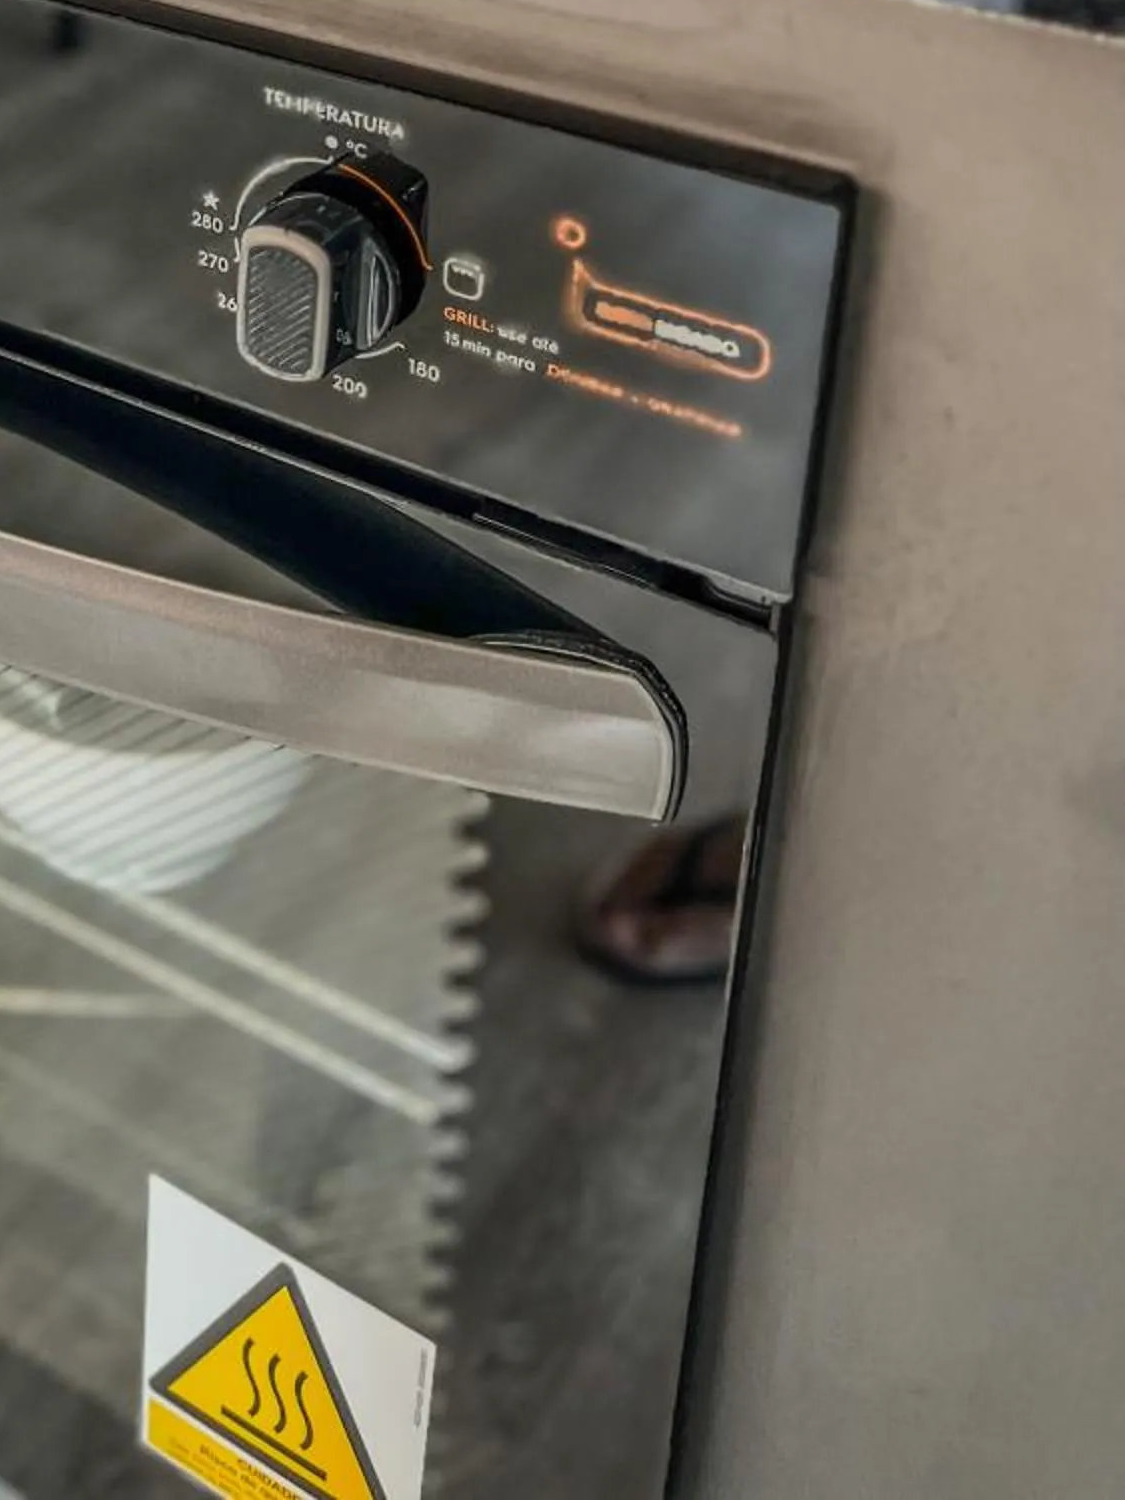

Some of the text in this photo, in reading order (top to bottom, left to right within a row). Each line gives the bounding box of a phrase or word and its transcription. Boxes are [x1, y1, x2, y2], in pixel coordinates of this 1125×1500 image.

[263, 86, 404, 140] TEMPERATURA
[191, 211, 223, 233] 280
[198, 250, 229, 273] 270
[217, 291, 237, 312] 26
[444, 307, 494, 333] GRILL:
[444, 331, 535, 372] 15 min para
[408, 357, 440, 382] 180
[332, 373, 367, 398] 200
